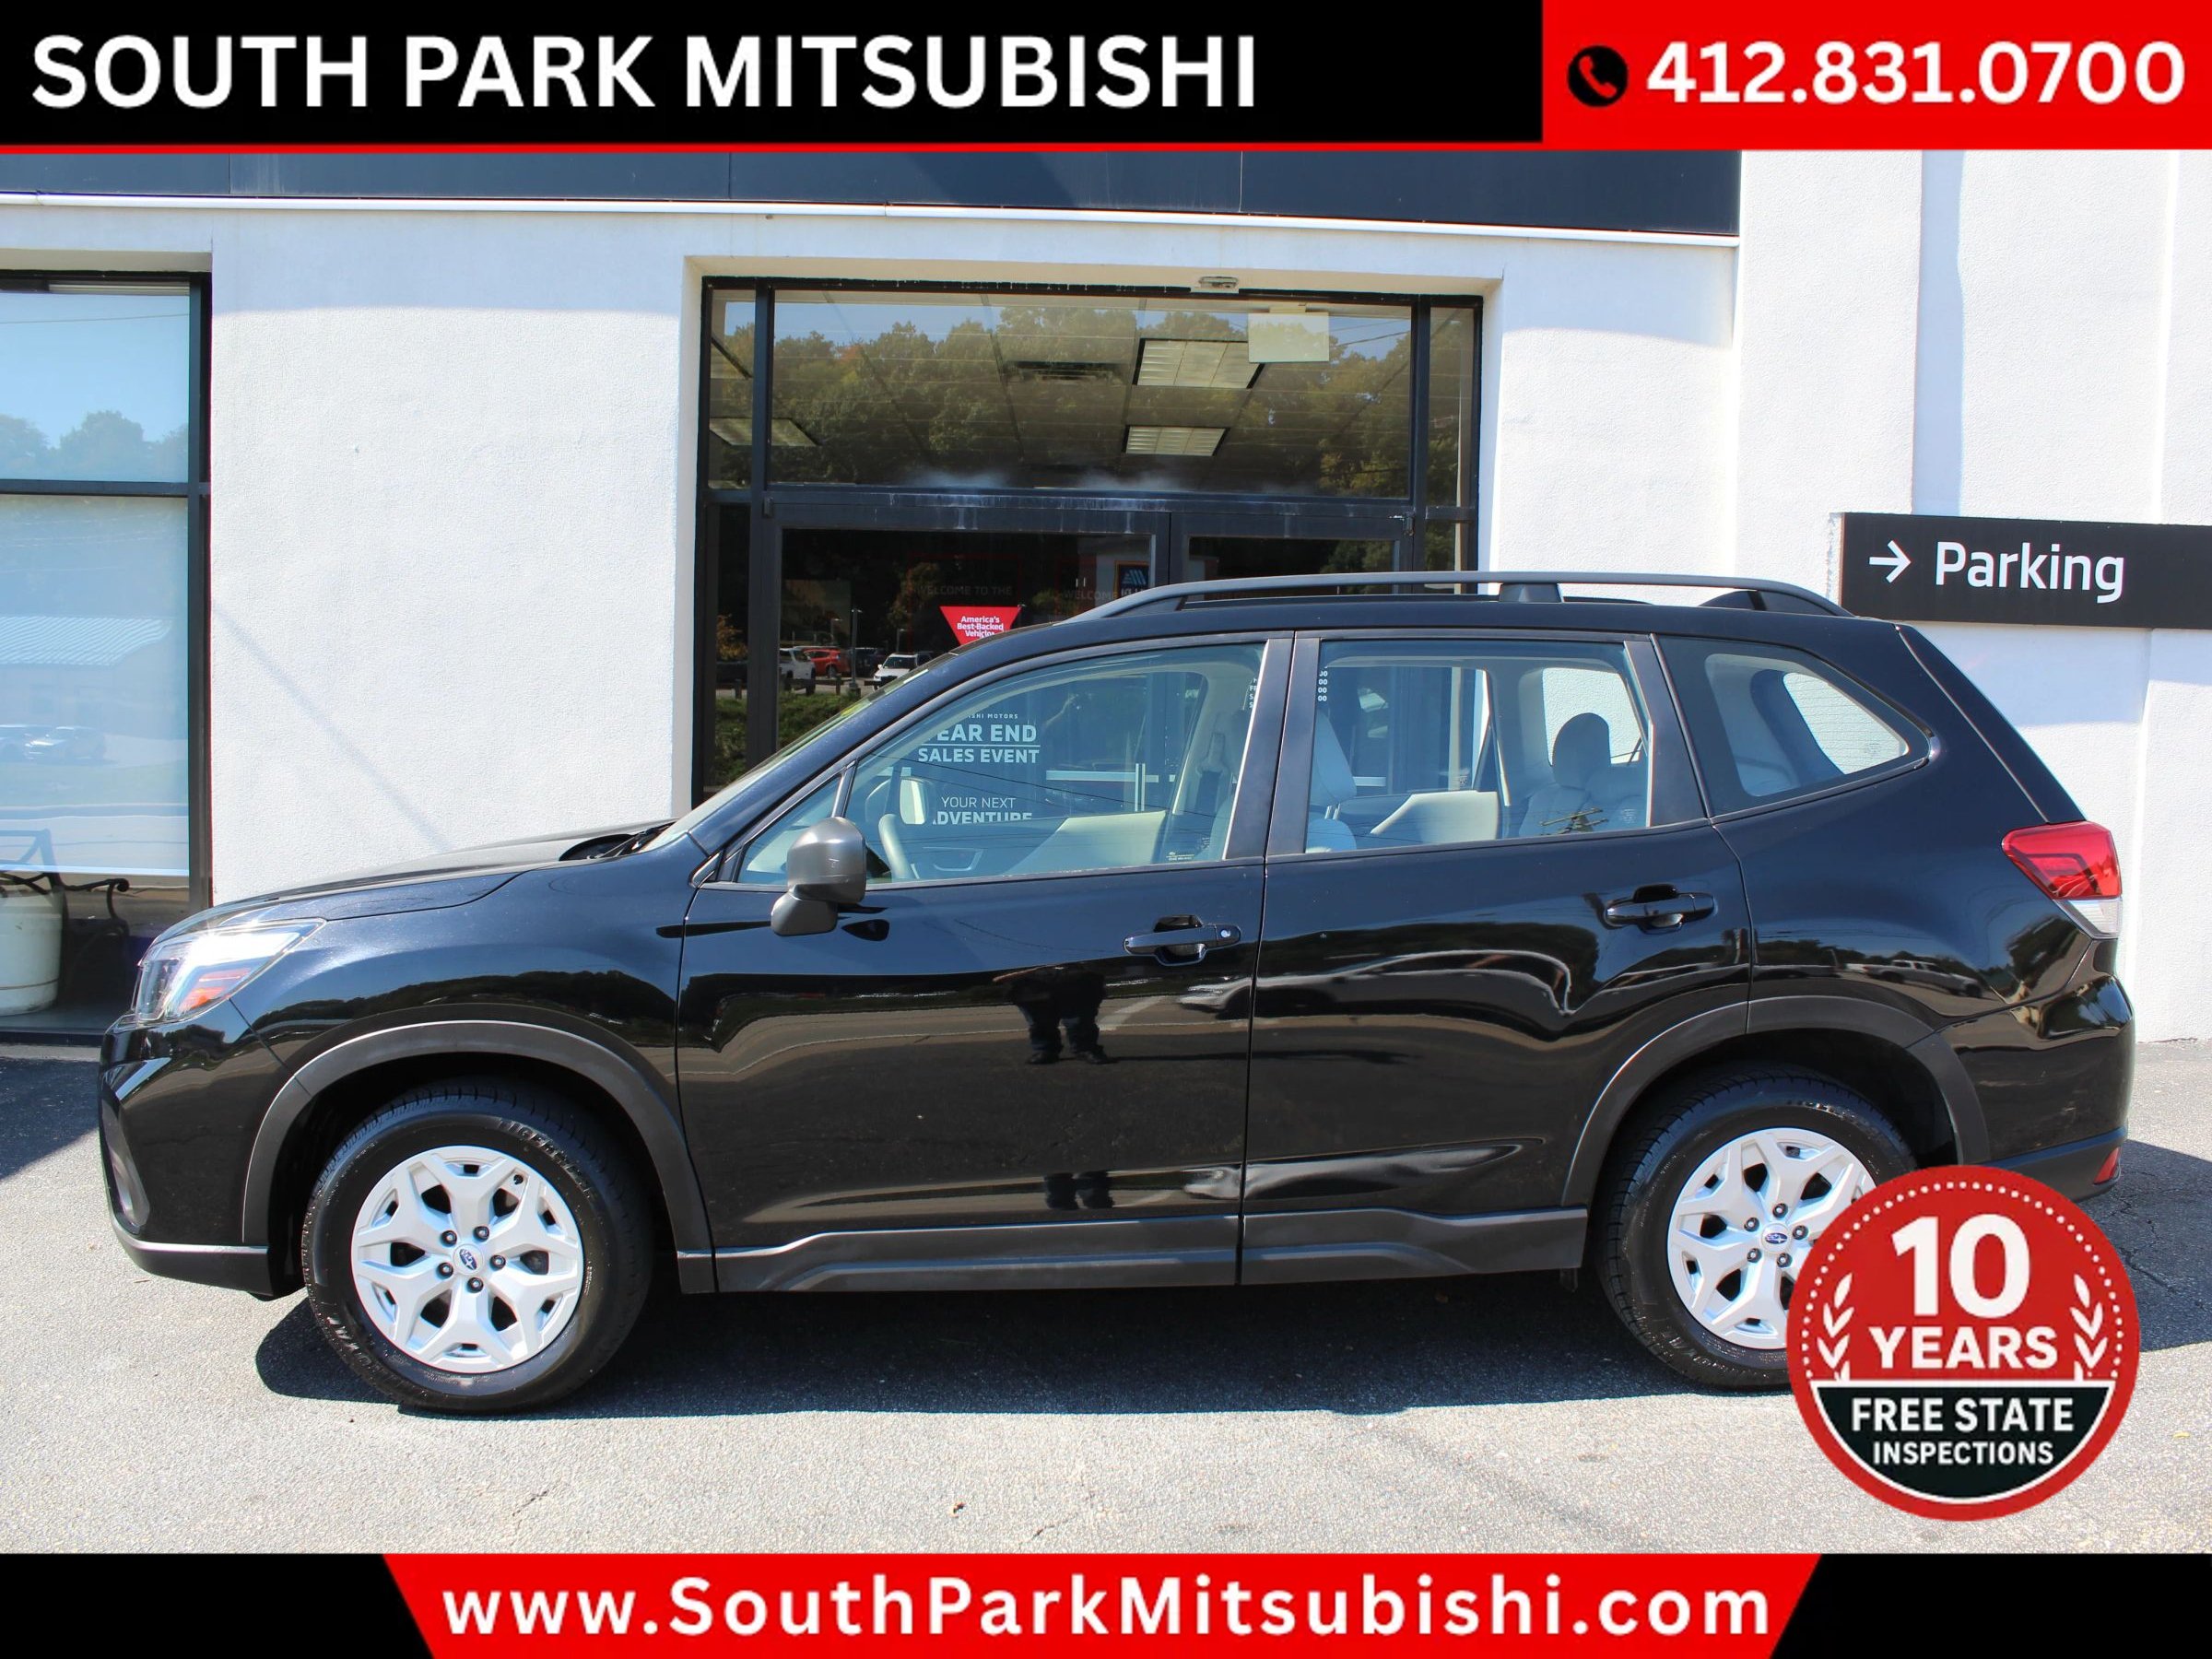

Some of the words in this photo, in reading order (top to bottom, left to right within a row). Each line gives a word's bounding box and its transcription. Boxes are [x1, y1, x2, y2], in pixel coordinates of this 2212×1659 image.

[1936, 541, 2124, 604] Parking
[929, 724, 982, 741] EAR
[991, 724, 1037, 742] END
[918, 747, 974, 762] SALES
[980, 749, 1040, 763] EVENT
[941, 796, 977, 808] YOUR
[982, 797, 1016, 808] NEXT
